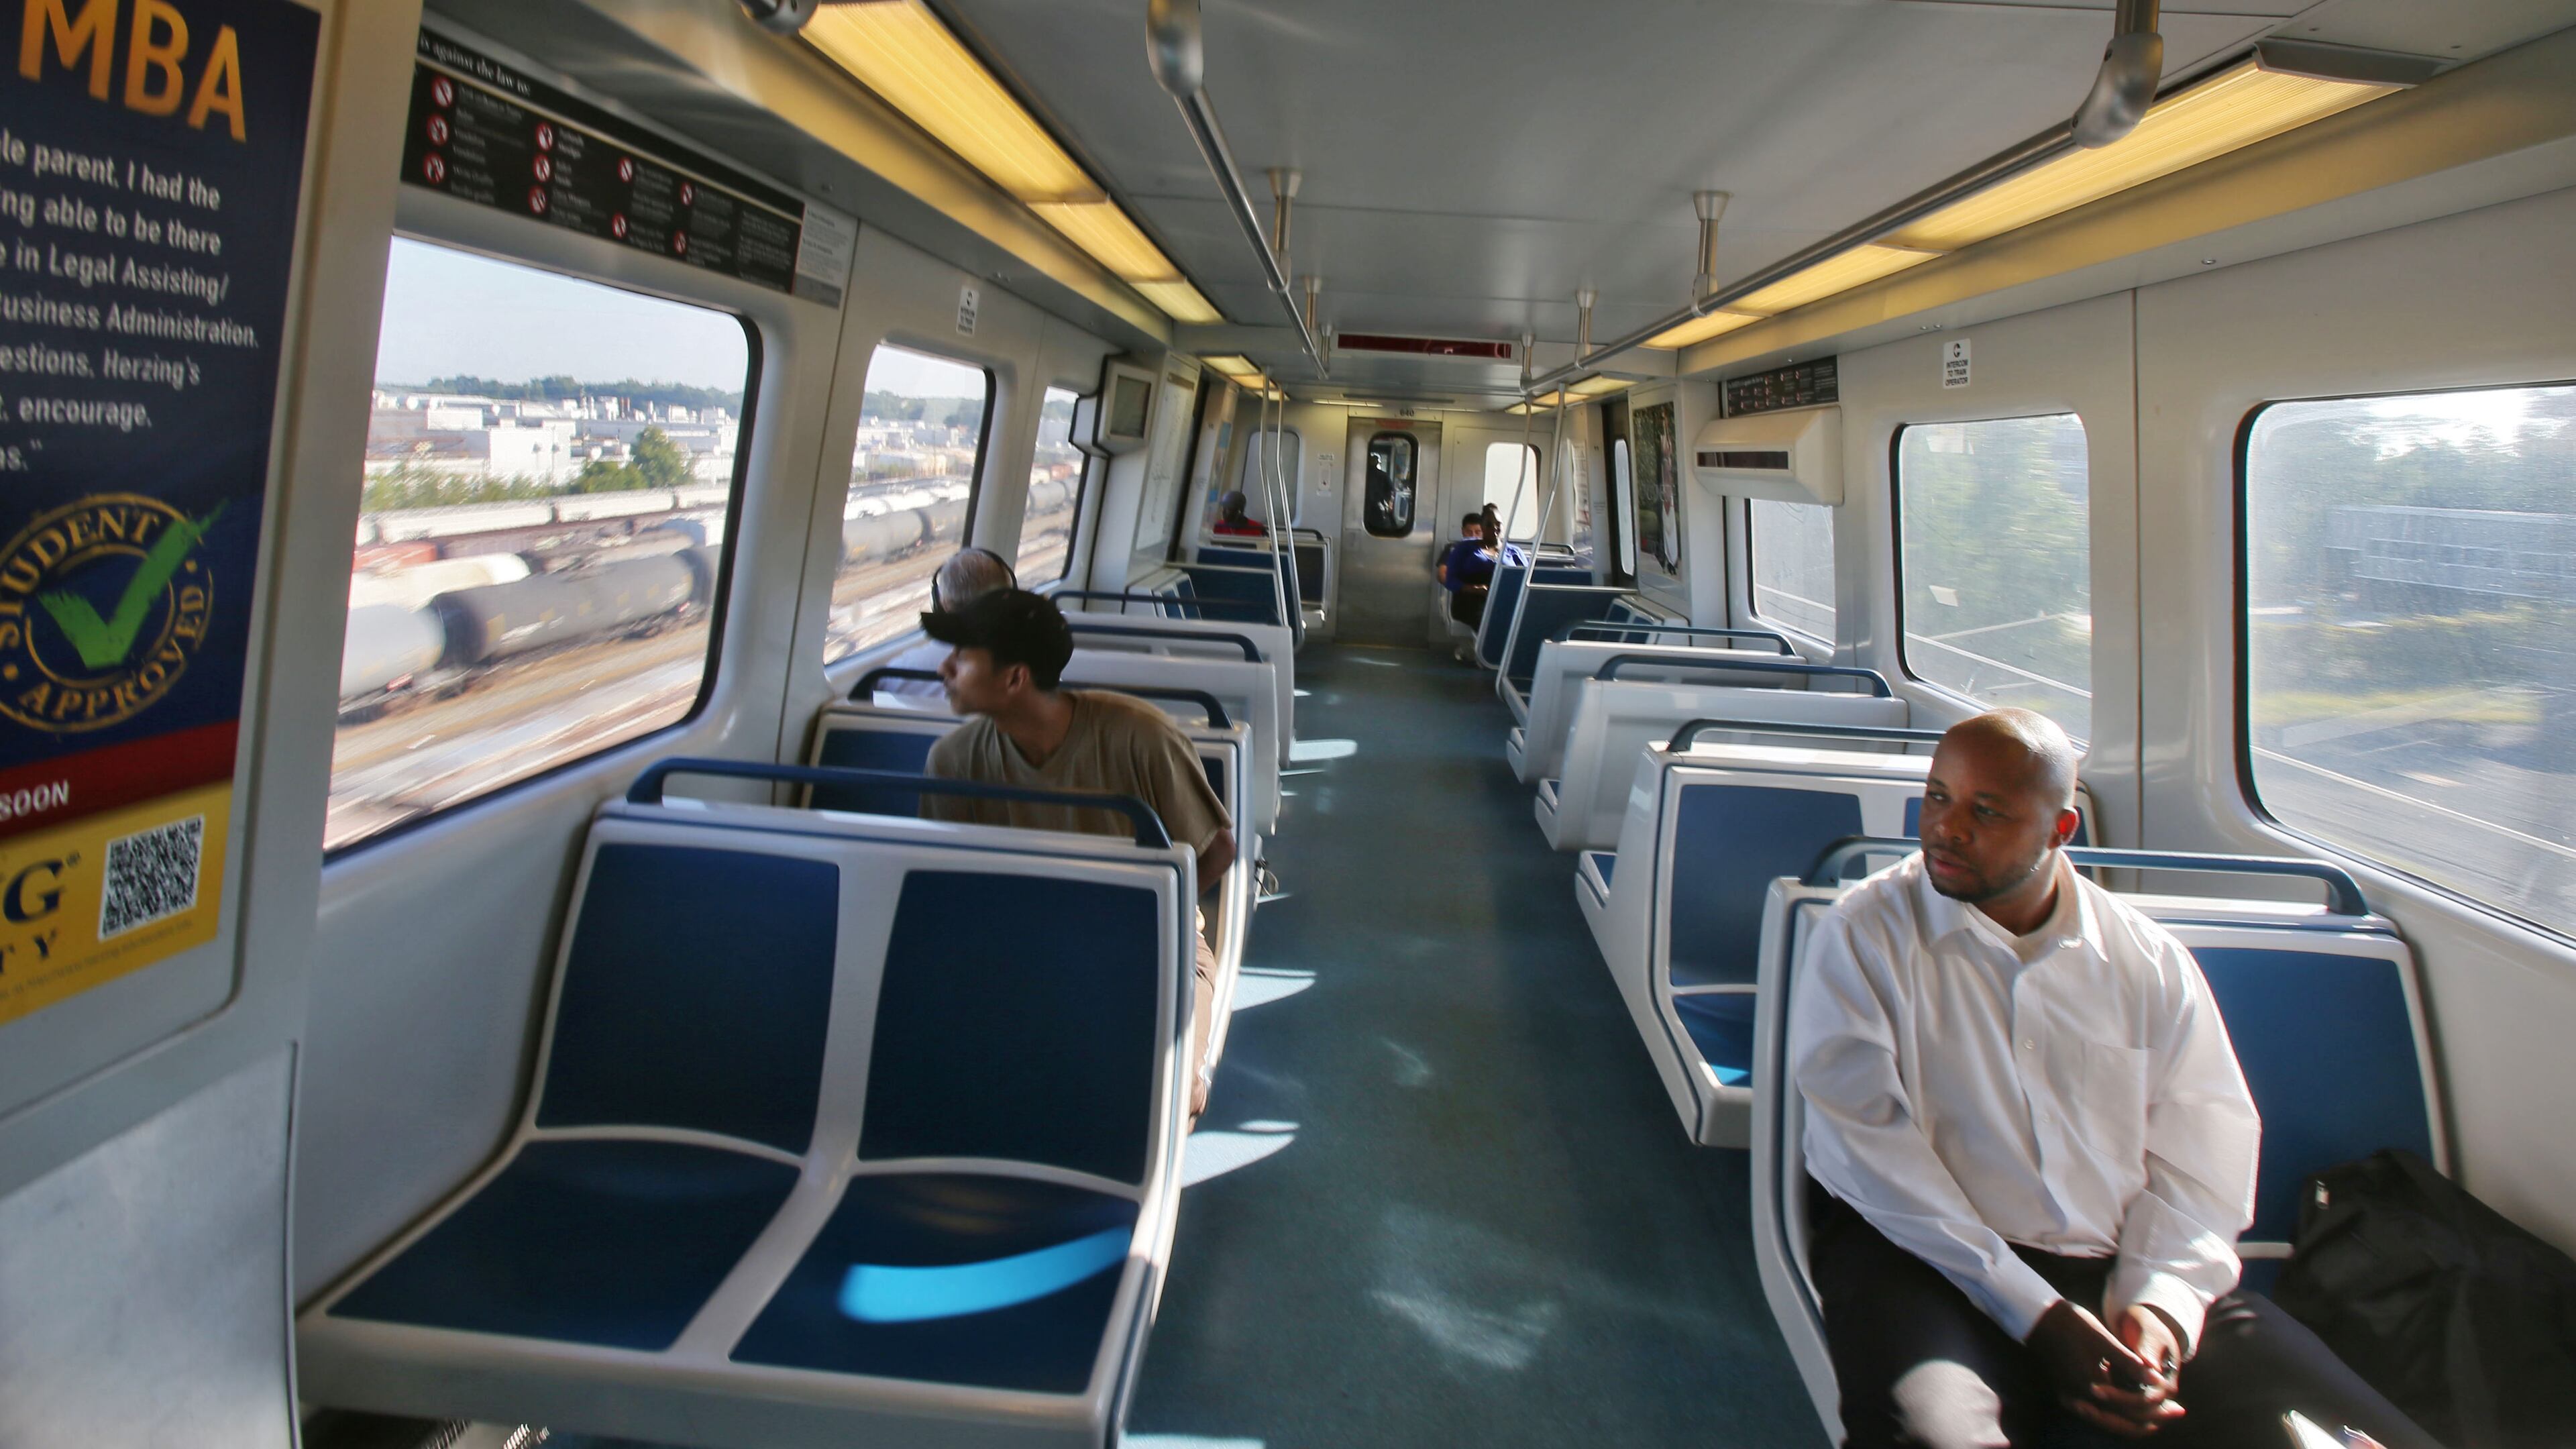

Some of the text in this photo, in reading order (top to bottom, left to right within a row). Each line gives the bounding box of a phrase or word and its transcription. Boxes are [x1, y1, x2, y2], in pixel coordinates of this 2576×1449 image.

[18, 0, 246, 144] MBA
[433, 42, 472, 71] against
[477, 58, 494, 80] the
[497, 65, 513, 87] law
[0, 127, 26, 166] le
[127, 160, 135, 191] I
[142, 163, 183, 201] had
[189, 176, 220, 211] the
[0, 188, 221, 256] ng able to be there
[15, 236, 40, 272] in
[49, 242, 116, 288] Legal
[121, 256, 229, 307] Assisting/
[0, 290, 259, 348] usiness Administration.
[104, 347, 201, 390] Herzing's
[18, 586, 204, 721] APPROVED
[0, 778, 69, 822] SOON
